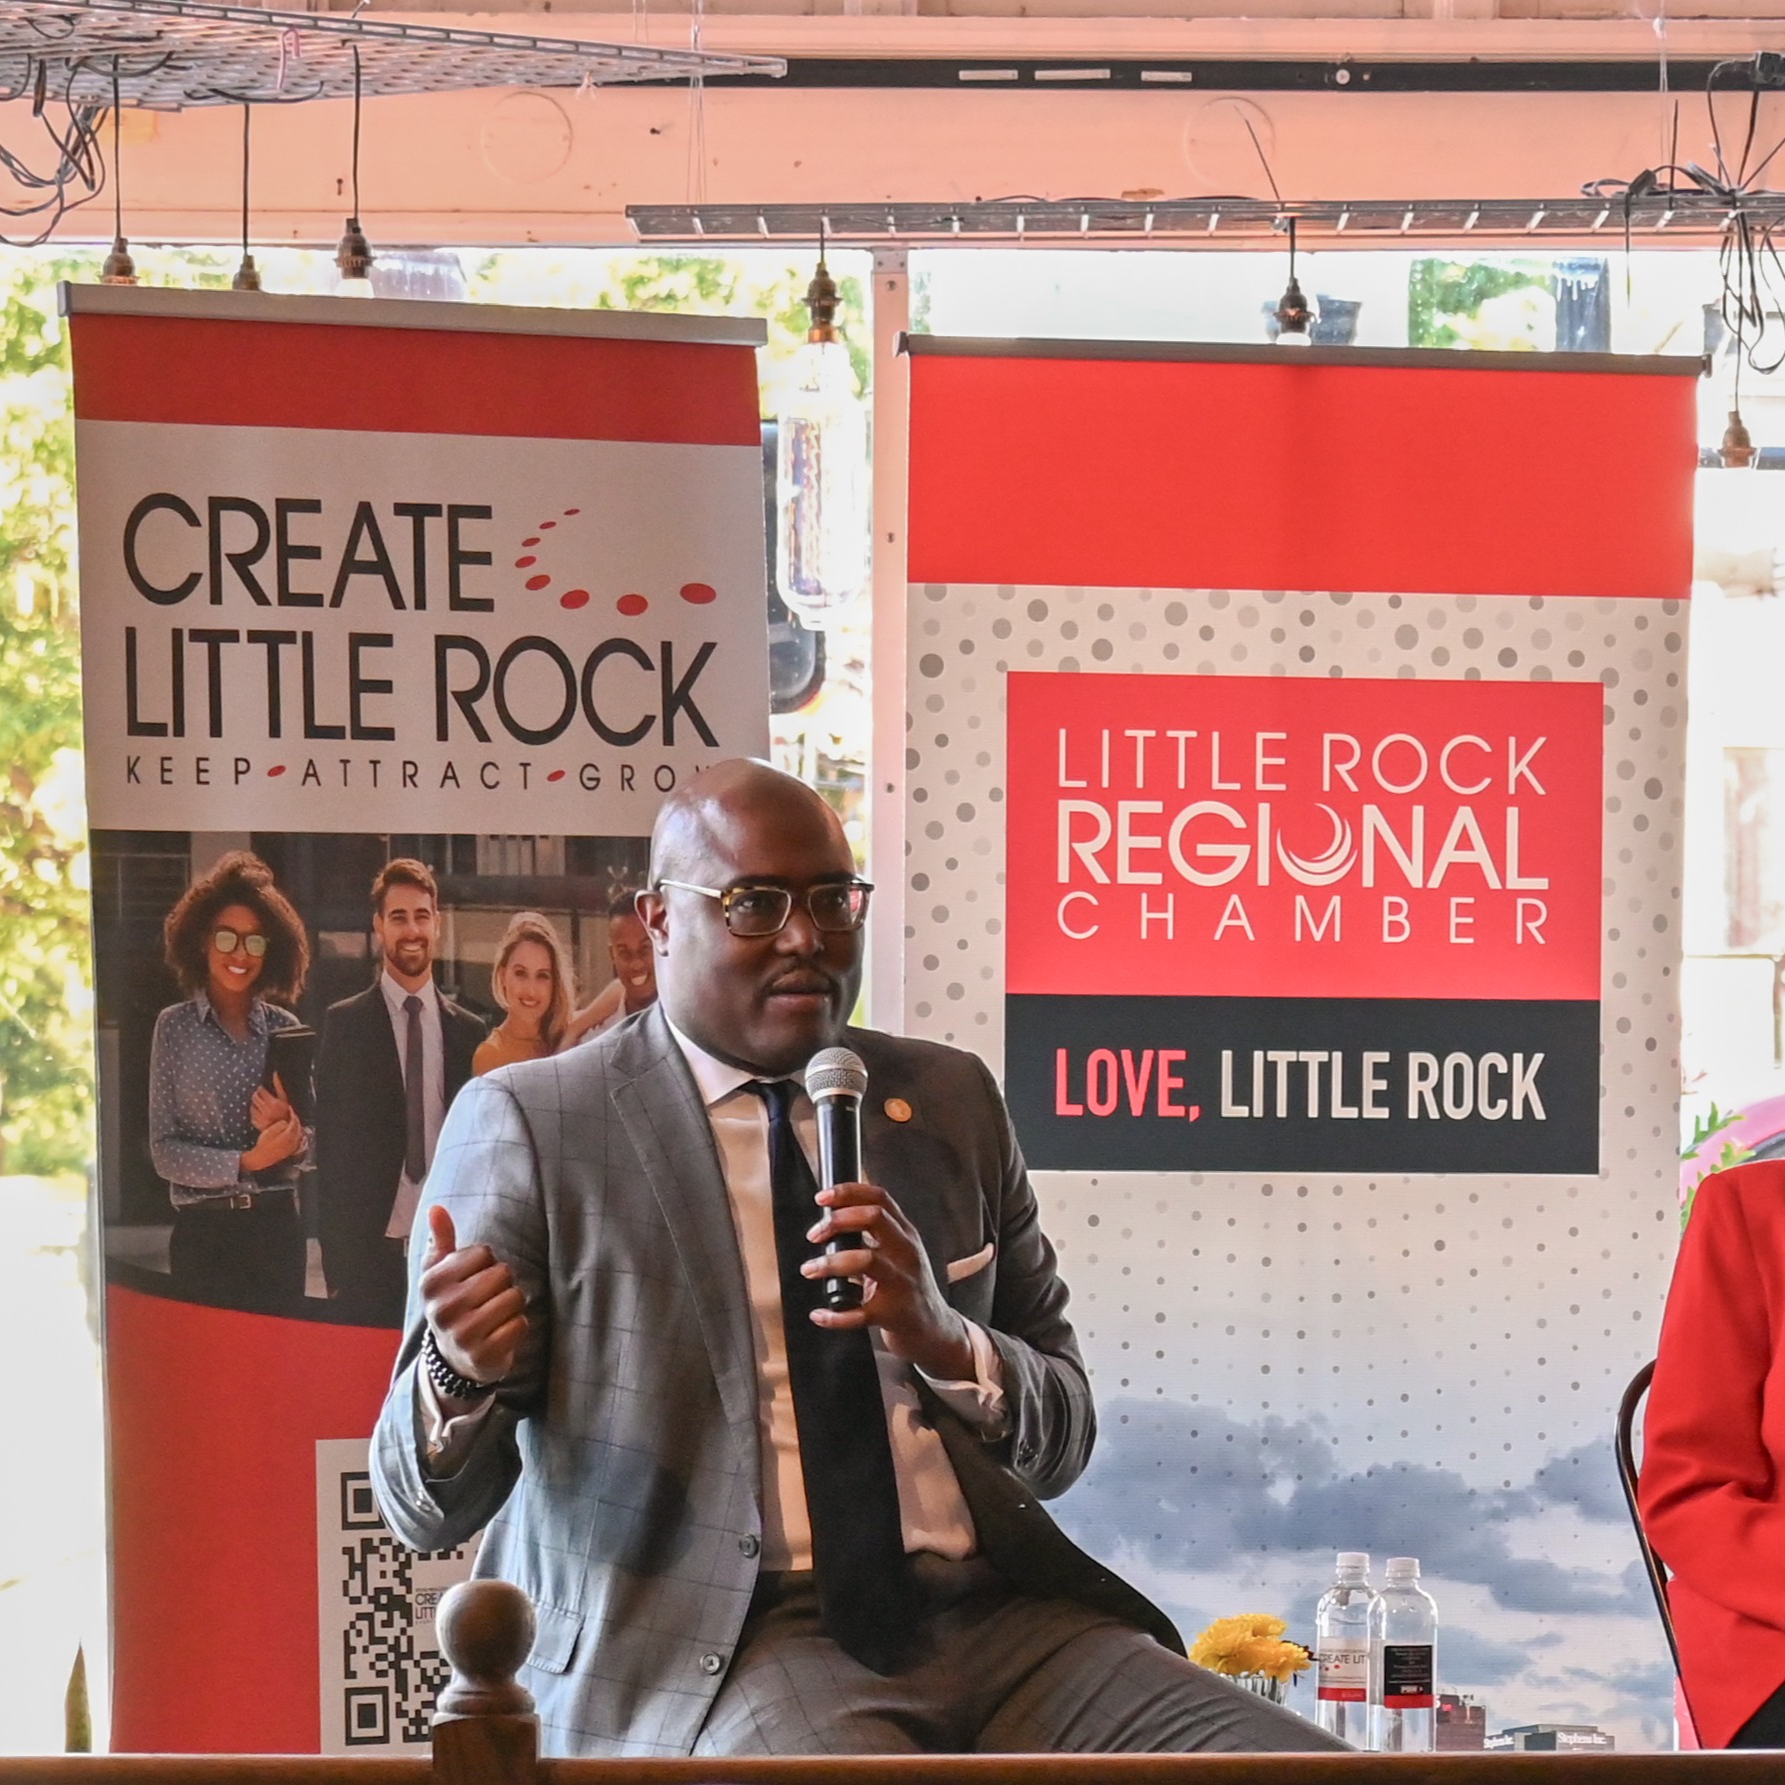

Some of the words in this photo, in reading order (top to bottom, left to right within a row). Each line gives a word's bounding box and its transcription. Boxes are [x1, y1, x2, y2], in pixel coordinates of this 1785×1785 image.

[123, 492, 495, 613] CREATE
[126, 626, 396, 741] LITTLE
[434, 635, 720, 748] ROCK
[127, 755, 251, 785] KEEP
[301, 758, 532, 791] ATTRACT
[579, 762, 711, 793] GRO
[1058, 728, 1287, 791] LITTLE
[1322, 733, 1548, 796] ROCK
[1057, 799, 1549, 889] REGIONAL
[1057, 891, 1549, 945] CHAMBER
[1055, 1047, 1201, 1123] LOVE,
[1221, 1049, 1390, 1119] LITTLE
[1407, 1051, 1547, 1121] ROCK
[415, 1592, 444, 1605] CRE
[1353, 1654, 1367, 1665] LIT
